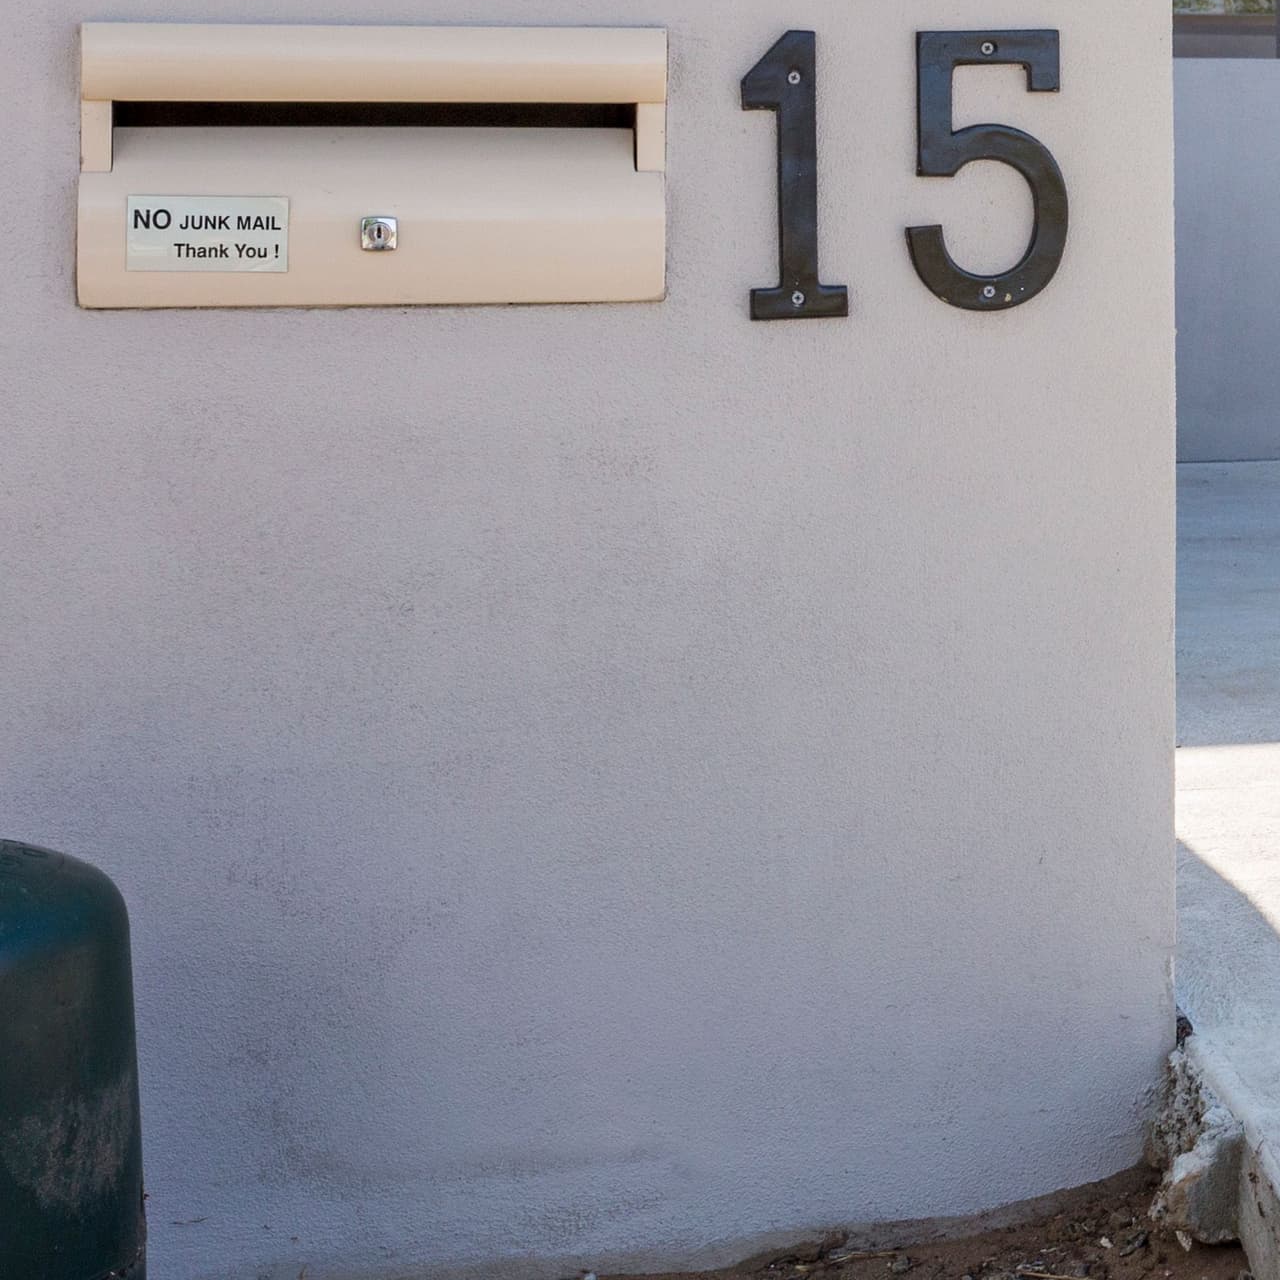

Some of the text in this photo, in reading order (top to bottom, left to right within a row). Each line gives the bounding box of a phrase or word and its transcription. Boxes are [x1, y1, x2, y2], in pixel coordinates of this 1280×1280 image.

[741, 29, 1068, 321] 15
[133, 209, 282, 230] NO JUNK MAIL
[174, 243, 229, 258] Thank
[234, 244, 268, 258] You
